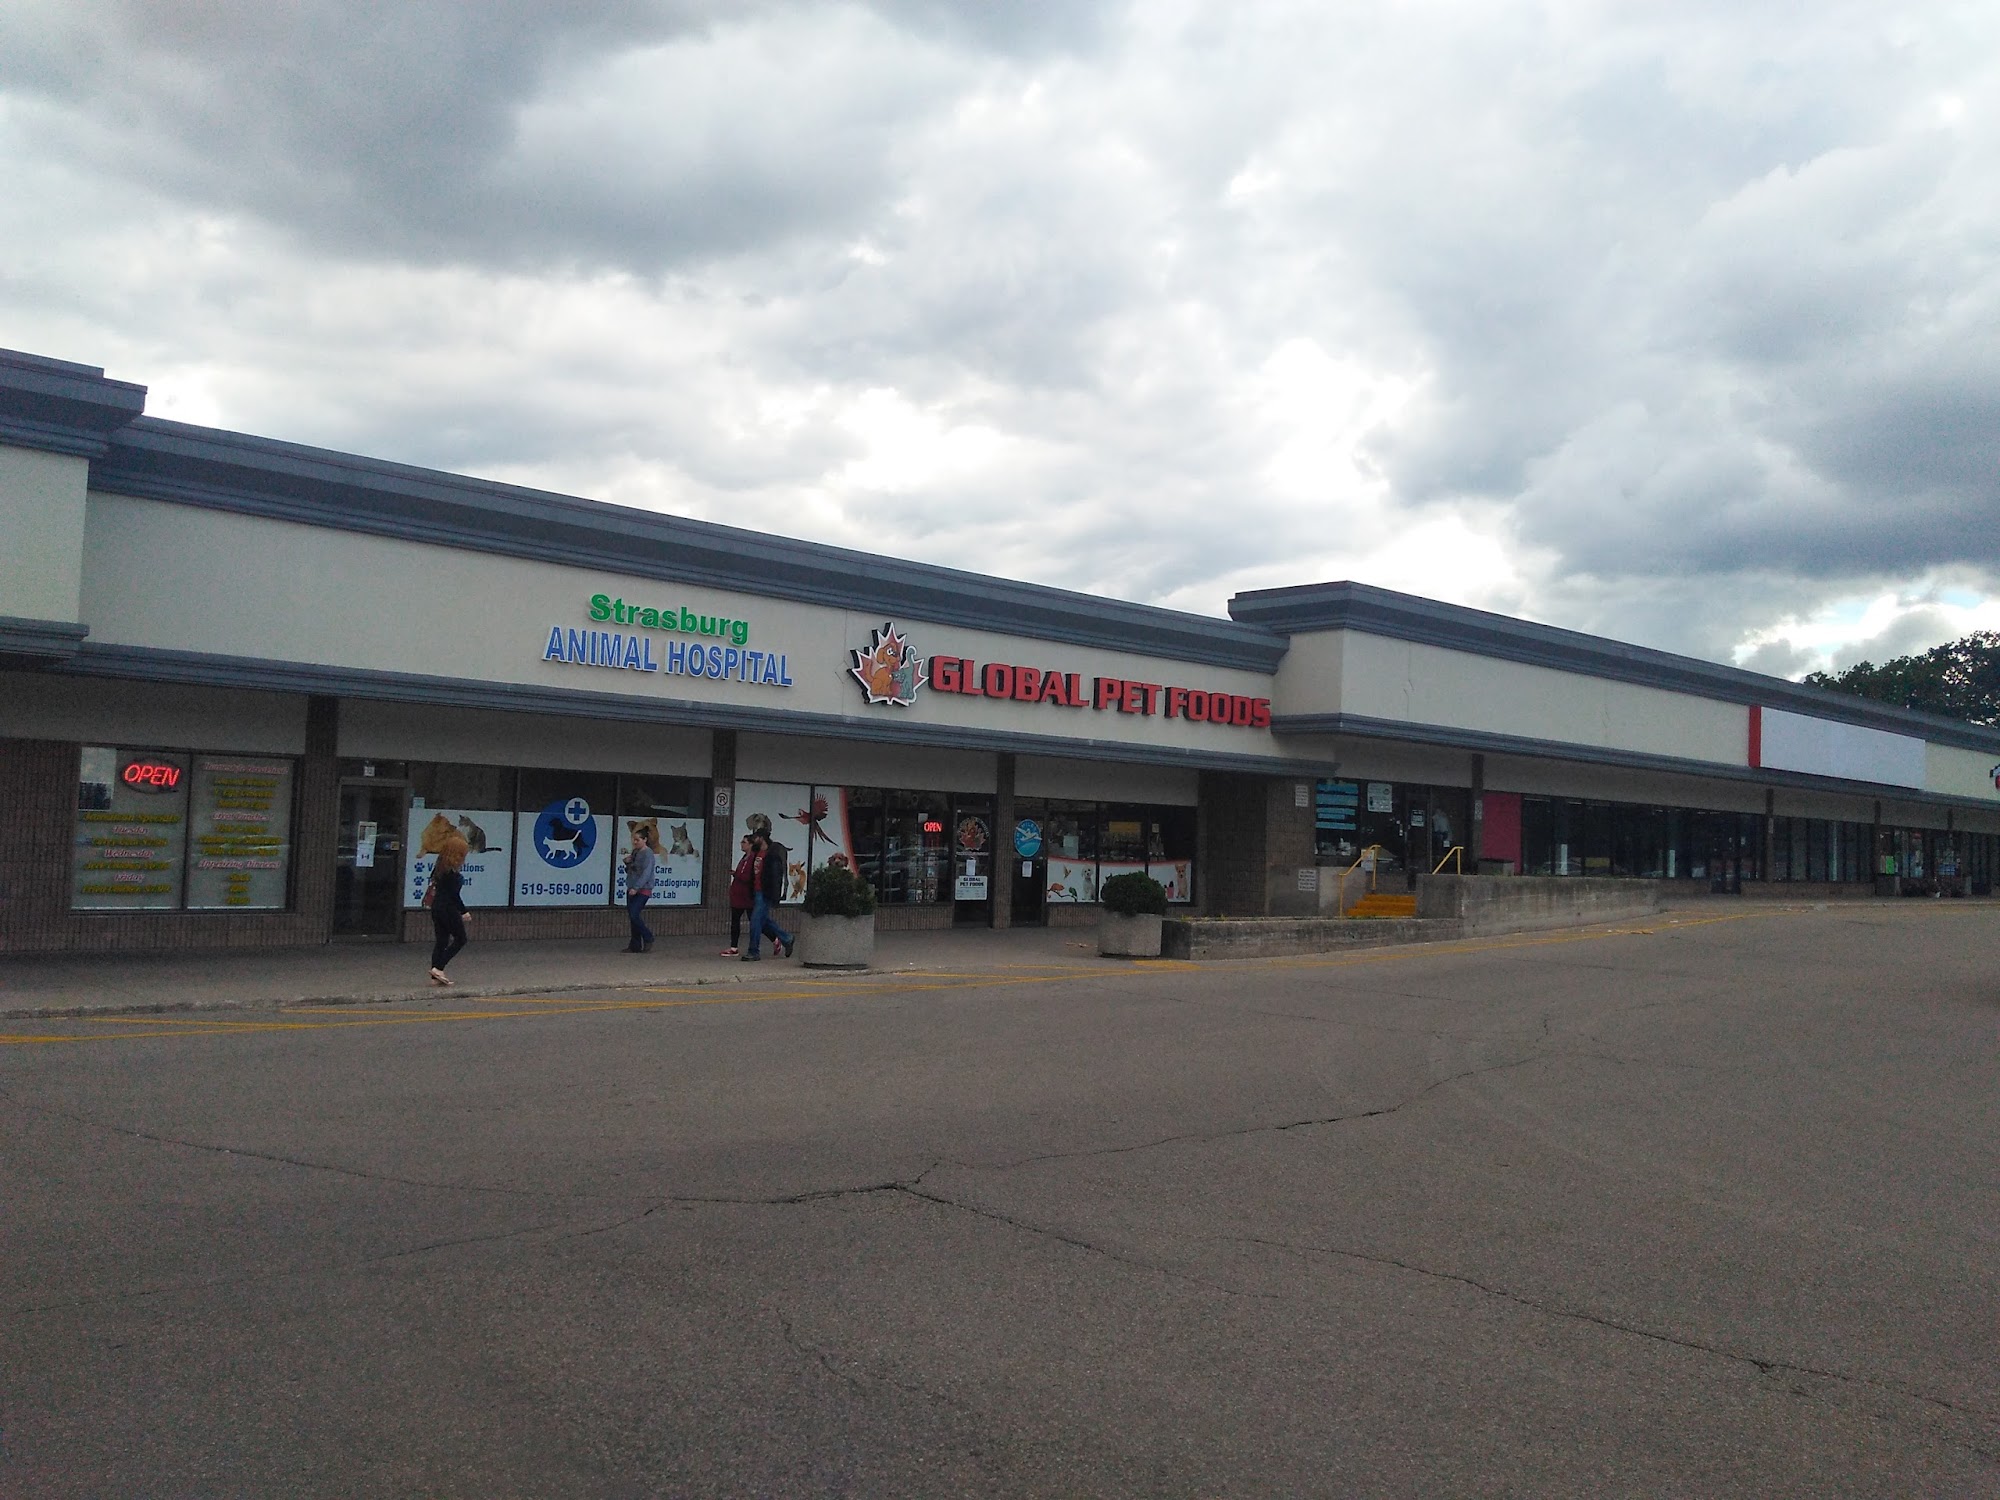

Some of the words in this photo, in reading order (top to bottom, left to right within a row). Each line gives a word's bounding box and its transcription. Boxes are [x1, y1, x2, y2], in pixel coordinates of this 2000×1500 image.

[589, 593, 749, 646] Strasburg
[543, 626, 658, 672] ANIMAL
[664, 640, 793, 687] HOSPITAL
[928, 655, 1090, 707] GLOBAL
[1094, 677, 1162, 716] PET
[1164, 686, 1271, 728] FOODS
[123, 764, 180, 788] OPEN
[923, 821, 943, 832] OPEN
[104, 849, 155, 859] Wednesday
[655, 865, 672, 874] Care
[654, 878, 700, 888] Radiography
[521, 883, 603, 896] 519-569-8000
[663, 890, 676, 899] Lab
